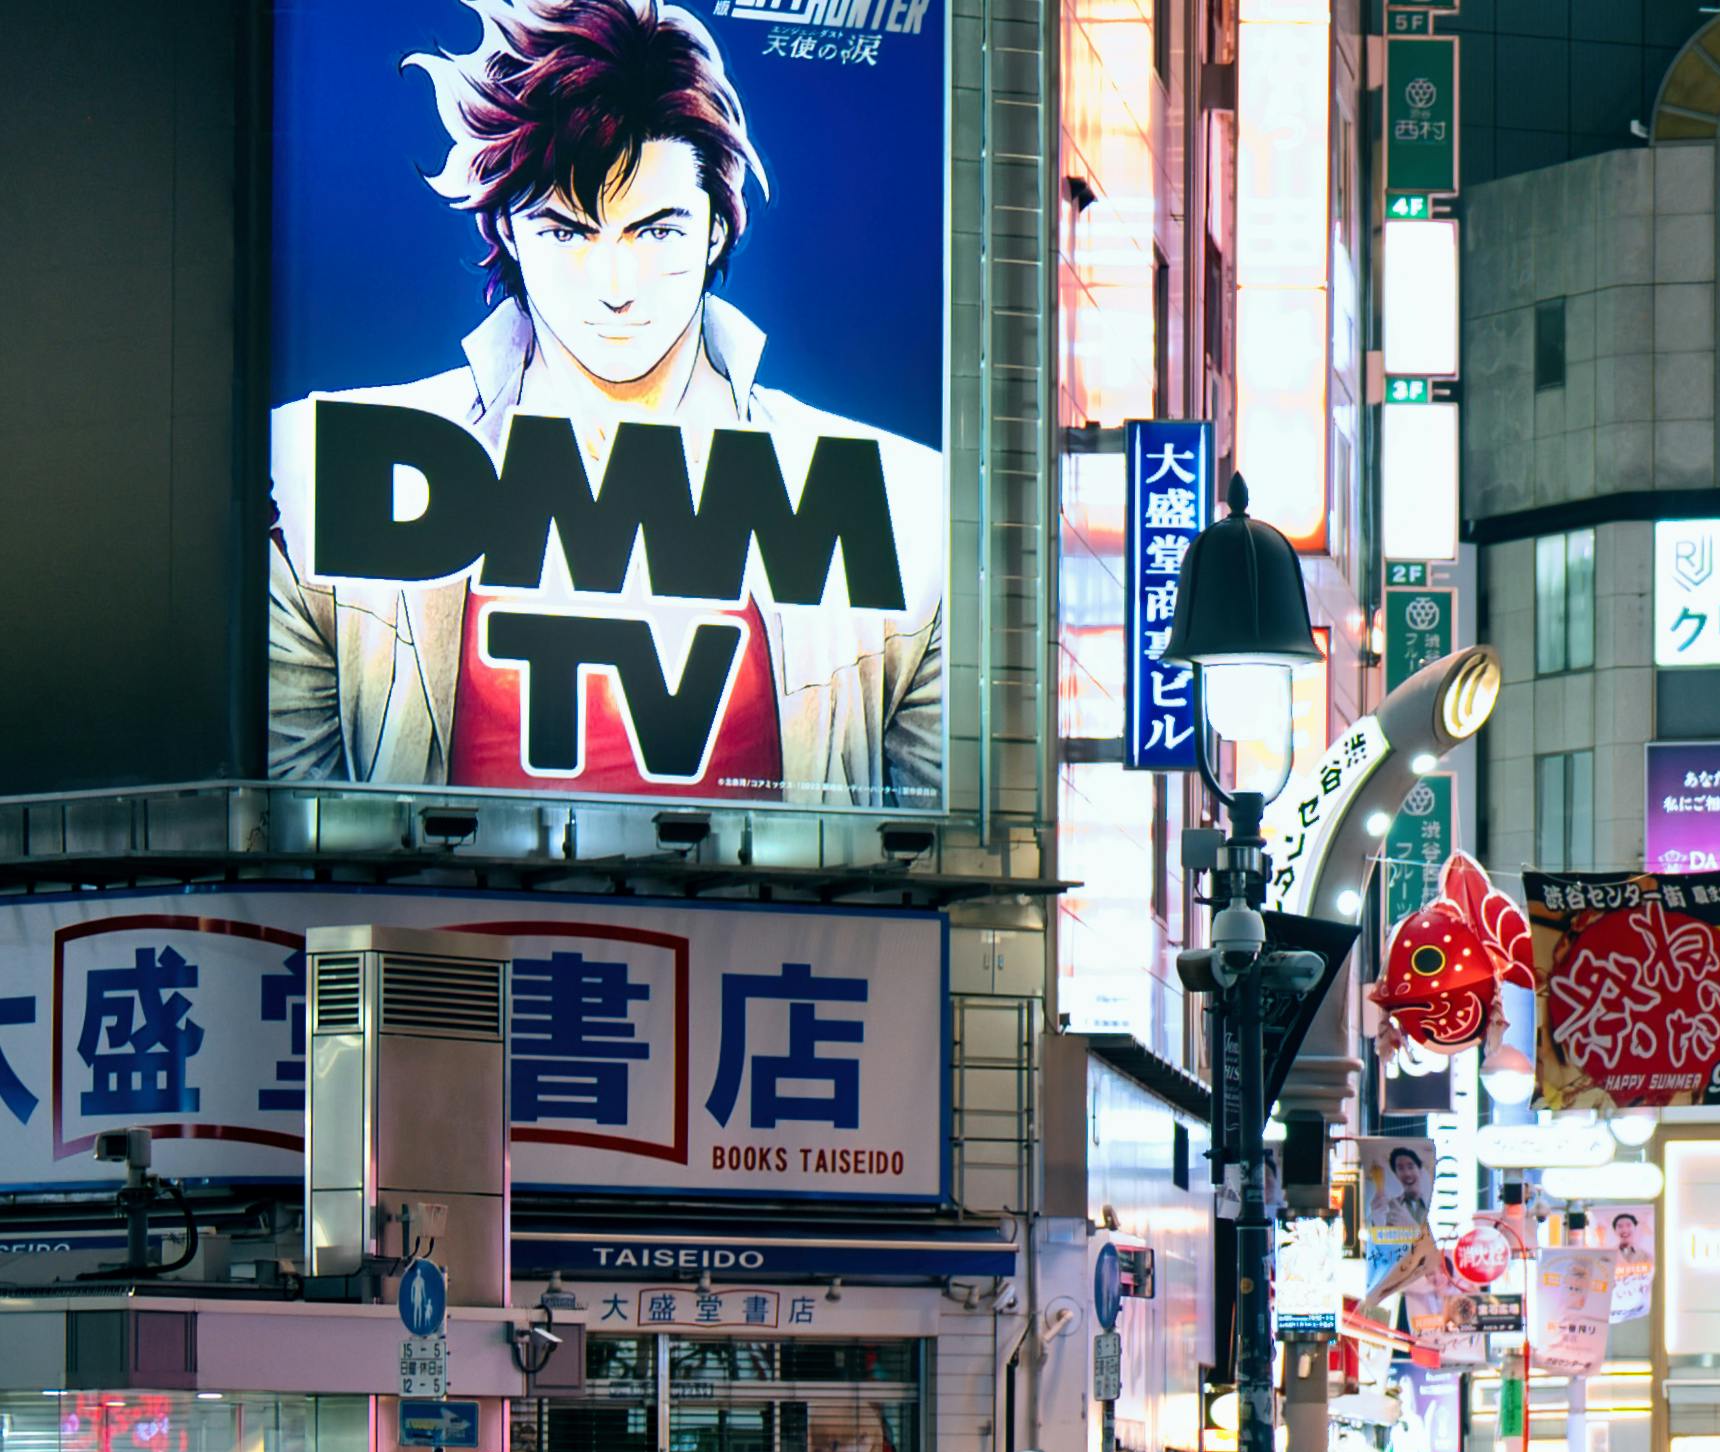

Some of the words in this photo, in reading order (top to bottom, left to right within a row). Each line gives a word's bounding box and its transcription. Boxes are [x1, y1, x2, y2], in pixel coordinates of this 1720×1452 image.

[1395, 15, 1424, 30] 5F
[1395, 120, 1446, 140] 西村
[1392, 197, 1424, 216] 4F
[1392, 380, 1424, 402] 3F
[314, 400, 906, 611] DMM
[1392, 564, 1422, 583] 2F
[487, 611, 737, 775] TV
[1689, 851, 1715, 870] DA
[1542, 883, 1687, 911] 渋谷センター街
[1605, 1075, 1646, 1091] HAPPY
[1648, 1073, 1703, 1089] SUMMER
[711, 1144, 789, 1173] BOOKS
[799, 1146, 905, 1176] TAISEIDO
[592, 1246, 765, 1270] TAISEIDO
[601, 1292, 817, 1326] 大盛堂書店
[402, 1343, 413, 1359] 15
[433, 1343, 441, 1358] 5
[402, 1378, 413, 1394] 12
[433, 1378, 441, 1393] 5
